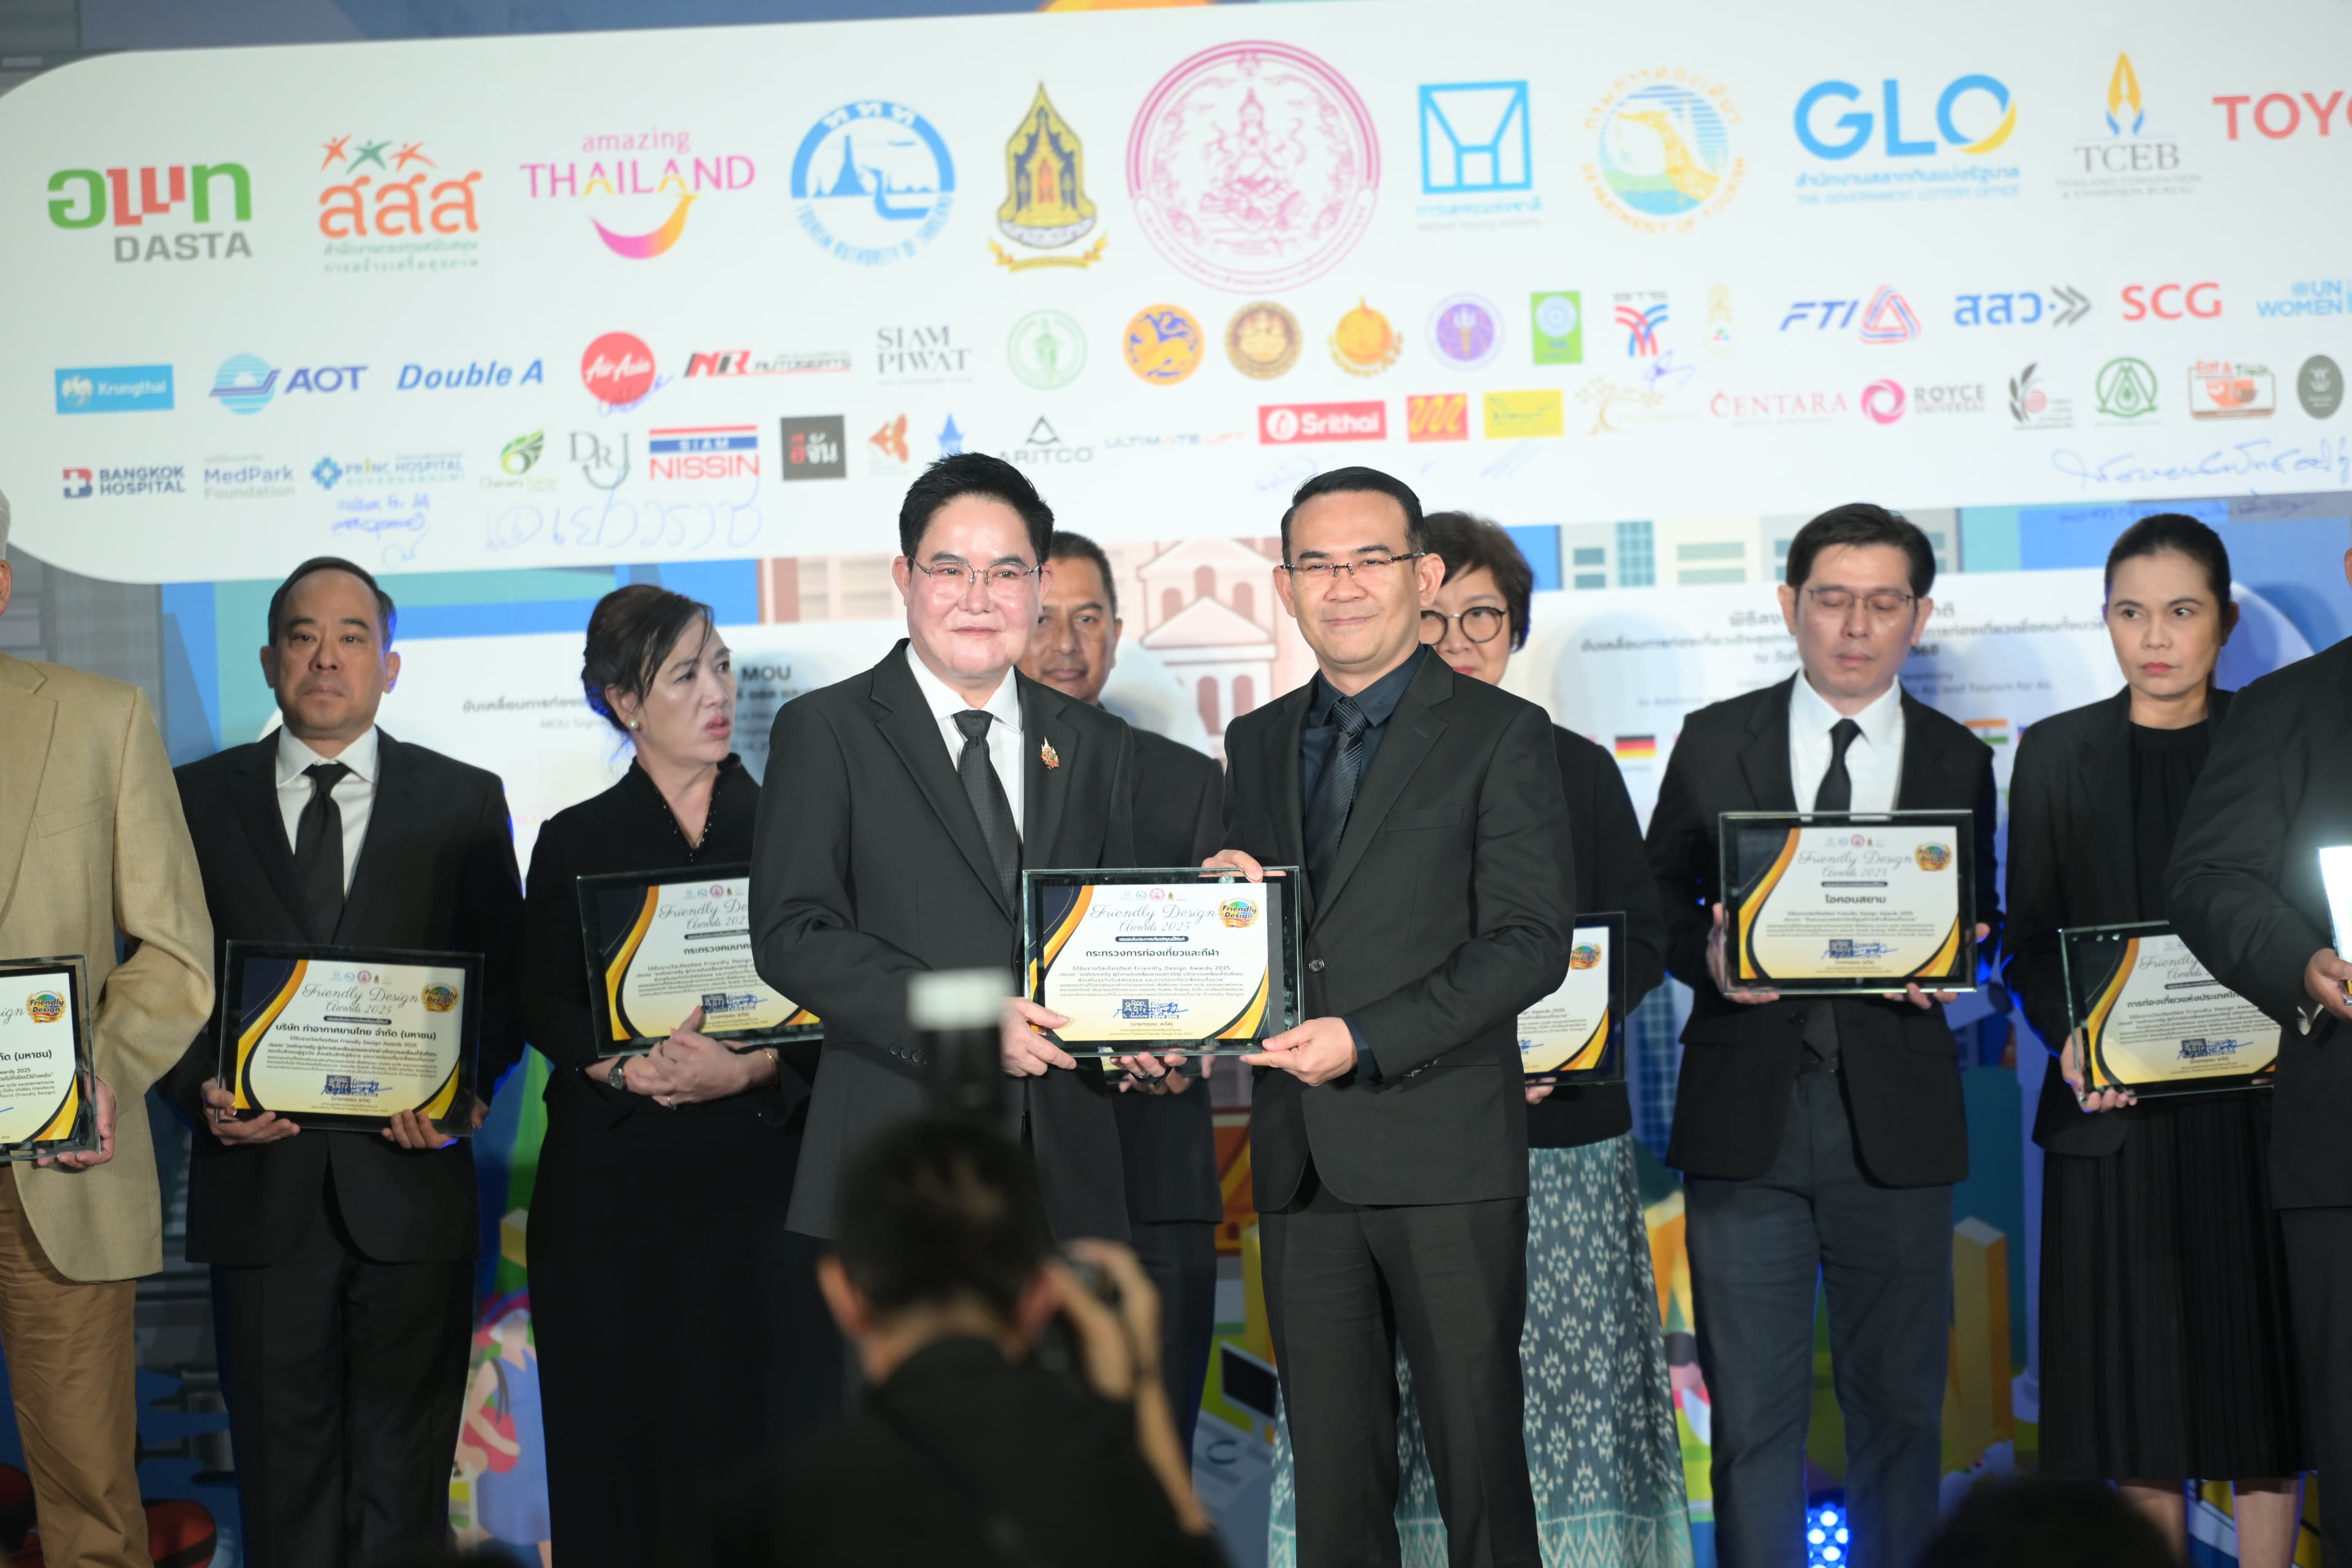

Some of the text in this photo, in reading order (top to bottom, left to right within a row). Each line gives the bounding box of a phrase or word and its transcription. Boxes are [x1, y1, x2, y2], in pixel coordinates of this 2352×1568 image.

[1793, 73, 2017, 161] GLO
[581, 127, 691, 155] amazing
[2073, 143, 2180, 173] TCEB
[519, 154, 755, 199] THAILAND
[318, 171, 483, 238] สสส
[114, 231, 254, 264] DASTA
[1954, 291, 2043, 328] สสว
[2120, 281, 2222, 322] SCG
[2256, 298, 2343, 318] WOMEN
[1779, 299, 1860, 332] FTI
[876, 325, 951, 349] SIAM
[877, 349, 973, 375] PIWAT
[284, 365, 369, 395] AOT
[396, 358, 544, 391] Double A
[98, 377, 167, 401] Krungthai
[1914, 383, 1986, 402] ROYCE
[1709, 389, 1849, 419] CENTARA
[1301, 411, 1379, 436] Srithai
[678, 437, 730, 452] SIAM
[790, 432, 839, 466] อีจัน
[1000, 447, 1093, 465] ARITCO
[99, 465, 185, 483] BANGKOK
[204, 465, 295, 484] MedPark
[395, 460, 464, 473] HOSPITAL
[649, 454, 761, 481] NISSIN
[99, 478, 187, 497] HOSPITAL
[204, 483, 295, 501] Foundation
[741, 664, 791, 682] MOU
[1797, 850, 1913, 870] Friendly Design
[1822, 867, 1856, 878] Awards
[1825, 894, 1887, 905] ไอคอนสยาม
[658, 901, 719, 921] Friendly
[1090, 903, 1216, 924] Friendly Design
[1222, 905, 1257, 914] Friendly
[1224, 911, 1253, 921] Design
[686, 915, 747, 931] Awards 202
[1118, 919, 1191, 932] Awards 2025
[684, 943, 752, 956] กระทรวงคมนาค
[1085, 946, 1219, 957] กระทรวงการท่องเที่ยวและกีฬา
[2139, 954, 2198, 970] Friendly
[2167, 967, 2203, 980] Awards
[29, 998, 64, 1008] Friendly
[301, 983, 420, 1010] Friendly Design
[424, 989, 458, 1000] Friendly
[426, 996, 453, 1006] Design
[2127, 990, 2241, 1008] การท่องเที่ยวแห่งประเทศไท
[0, 1008, 24, 1025] ign
[325, 1000, 393, 1016] Awards 2025
[275, 1023, 437, 1041] บริษัท ท่าอากาศยานไทย จำกัด (มหาชน)
[14, 1049, 53, 1062] (มหาชน)
